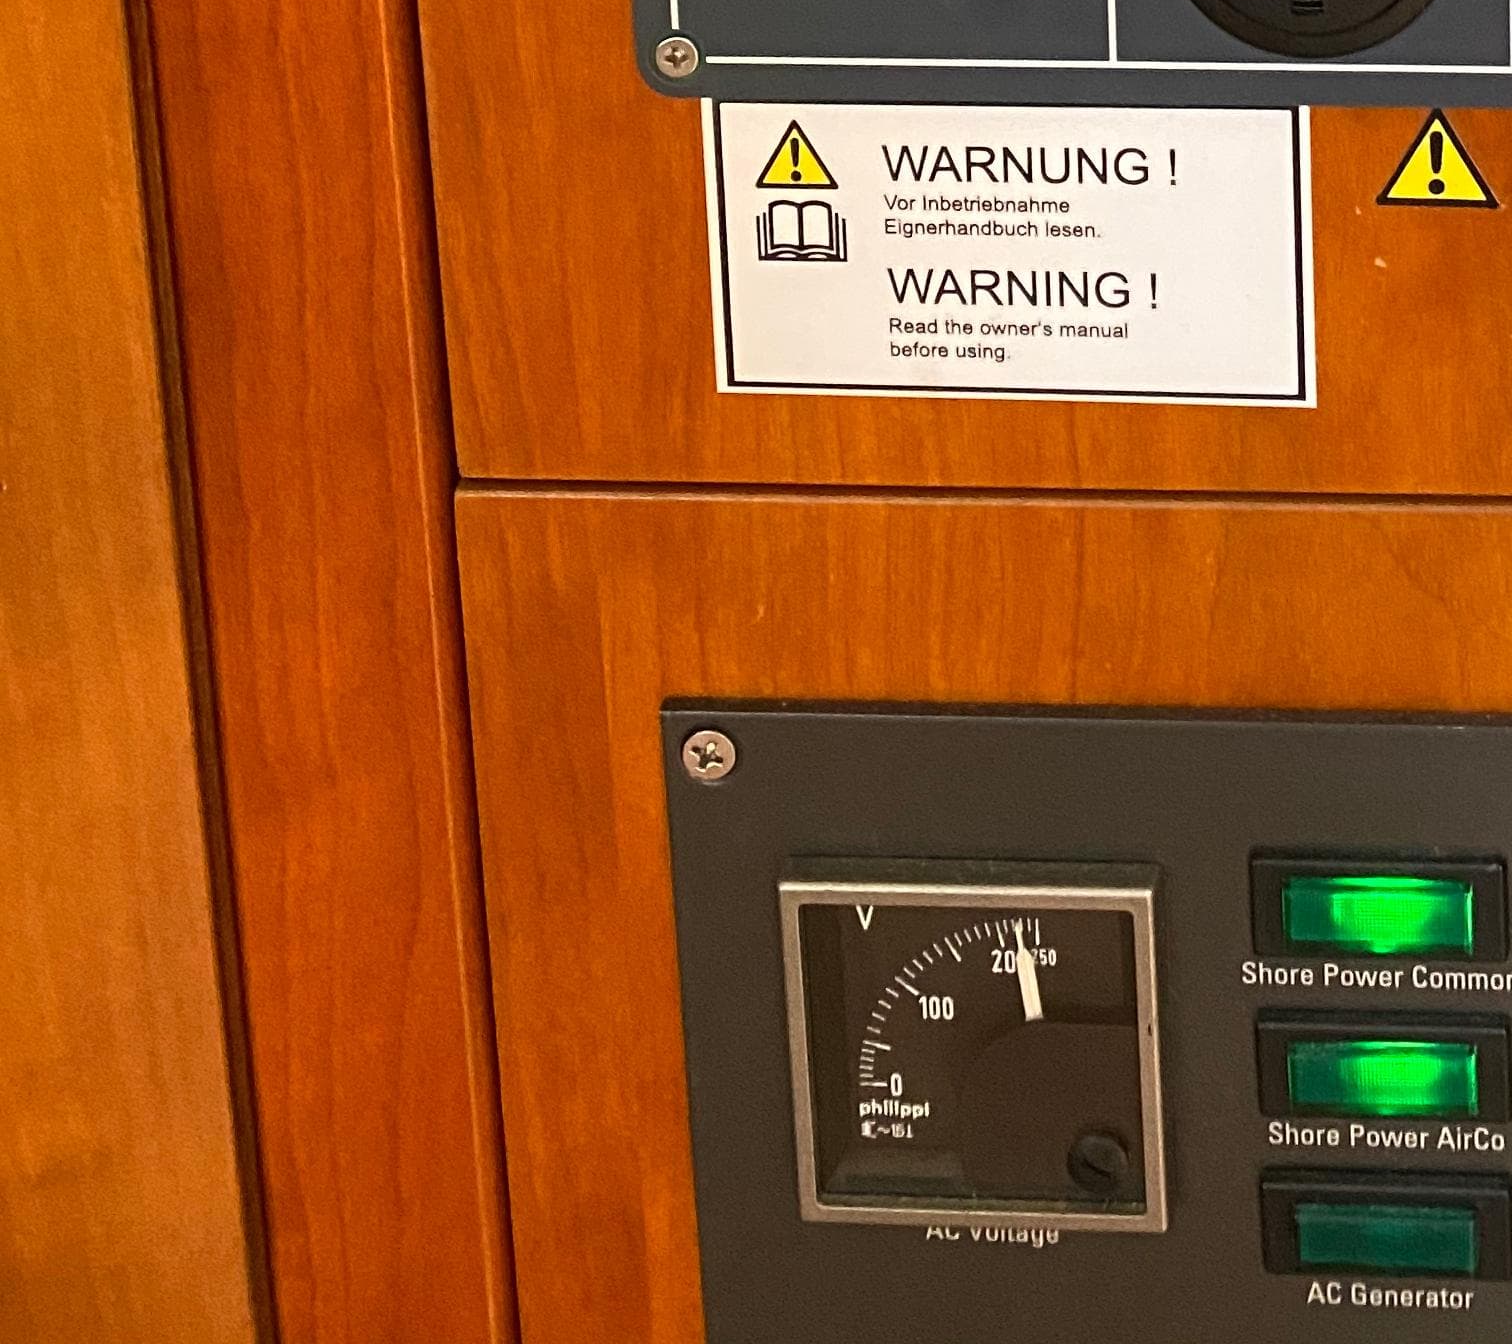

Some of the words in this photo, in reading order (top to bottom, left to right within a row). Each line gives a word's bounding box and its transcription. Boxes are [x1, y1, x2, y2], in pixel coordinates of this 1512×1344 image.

[881, 144, 1149, 186] WARNUNG
[1169, 148, 1177, 186] !
[883, 194, 917, 211] Vor
[922, 195, 1070, 214] Inbetriebnahme
[884, 218, 1038, 239] Eignerhandbuch
[1045, 221, 1101, 239] lesen.
[887, 267, 1130, 309] WARNING
[1150, 272, 1157, 310] !
[889, 317, 938, 334] Read
[944, 319, 973, 335] the
[980, 321, 1053, 337] owner's
[1059, 323, 1128, 339] manual
[890, 341, 949, 358] before
[955, 346, 1011, 364] using.
[855, 905, 874, 931] V
[991, 949, 1017, 974] 20
[1242, 961, 1314, 986] Shore
[1324, 962, 1404, 989] Power
[918, 996, 954, 1021] 100
[890, 1072, 903, 1097] 0
[1268, 1121, 1340, 1146] Shore
[1350, 1123, 1430, 1149] Power
[1437, 1126, 1505, 1151] AirCo
[1307, 1281, 1342, 1305] AC
[1351, 1282, 1474, 1309] Generator
